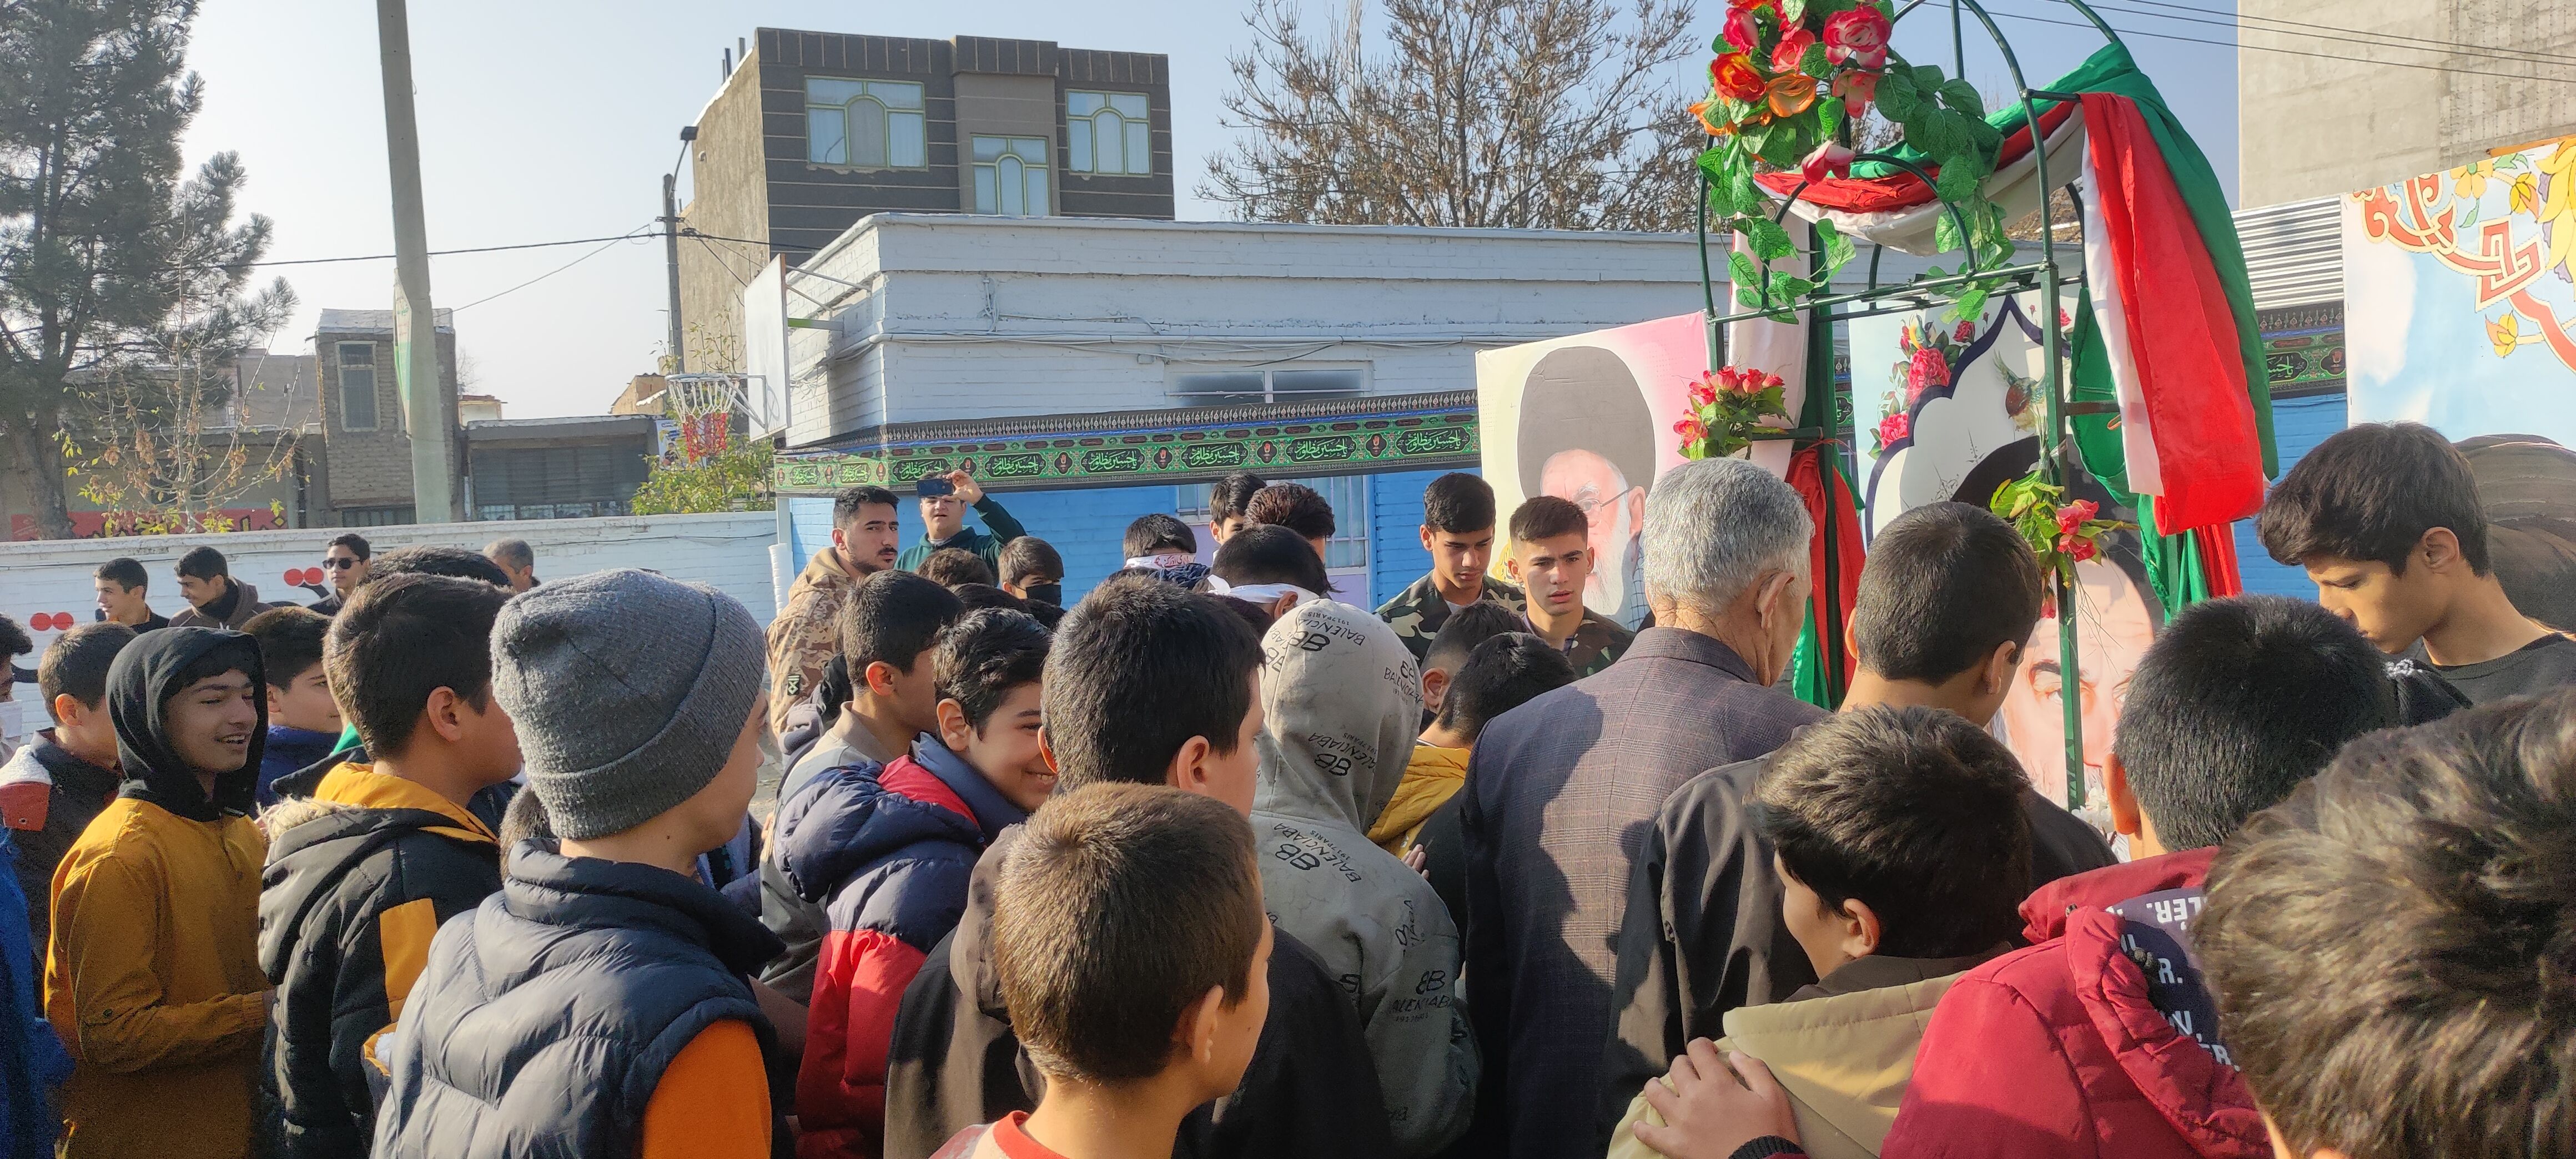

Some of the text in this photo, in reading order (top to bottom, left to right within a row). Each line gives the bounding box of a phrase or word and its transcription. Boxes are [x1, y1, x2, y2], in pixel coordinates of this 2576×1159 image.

[1307, 612, 1350, 626] 1917PARIS
[1308, 732, 1376, 769] ALENCIABA
[1274, 823, 1362, 882] BALENCIABA
[1310, 830, 1351, 860] 1917PARIS
[2146, 896, 2206, 924] LER.
